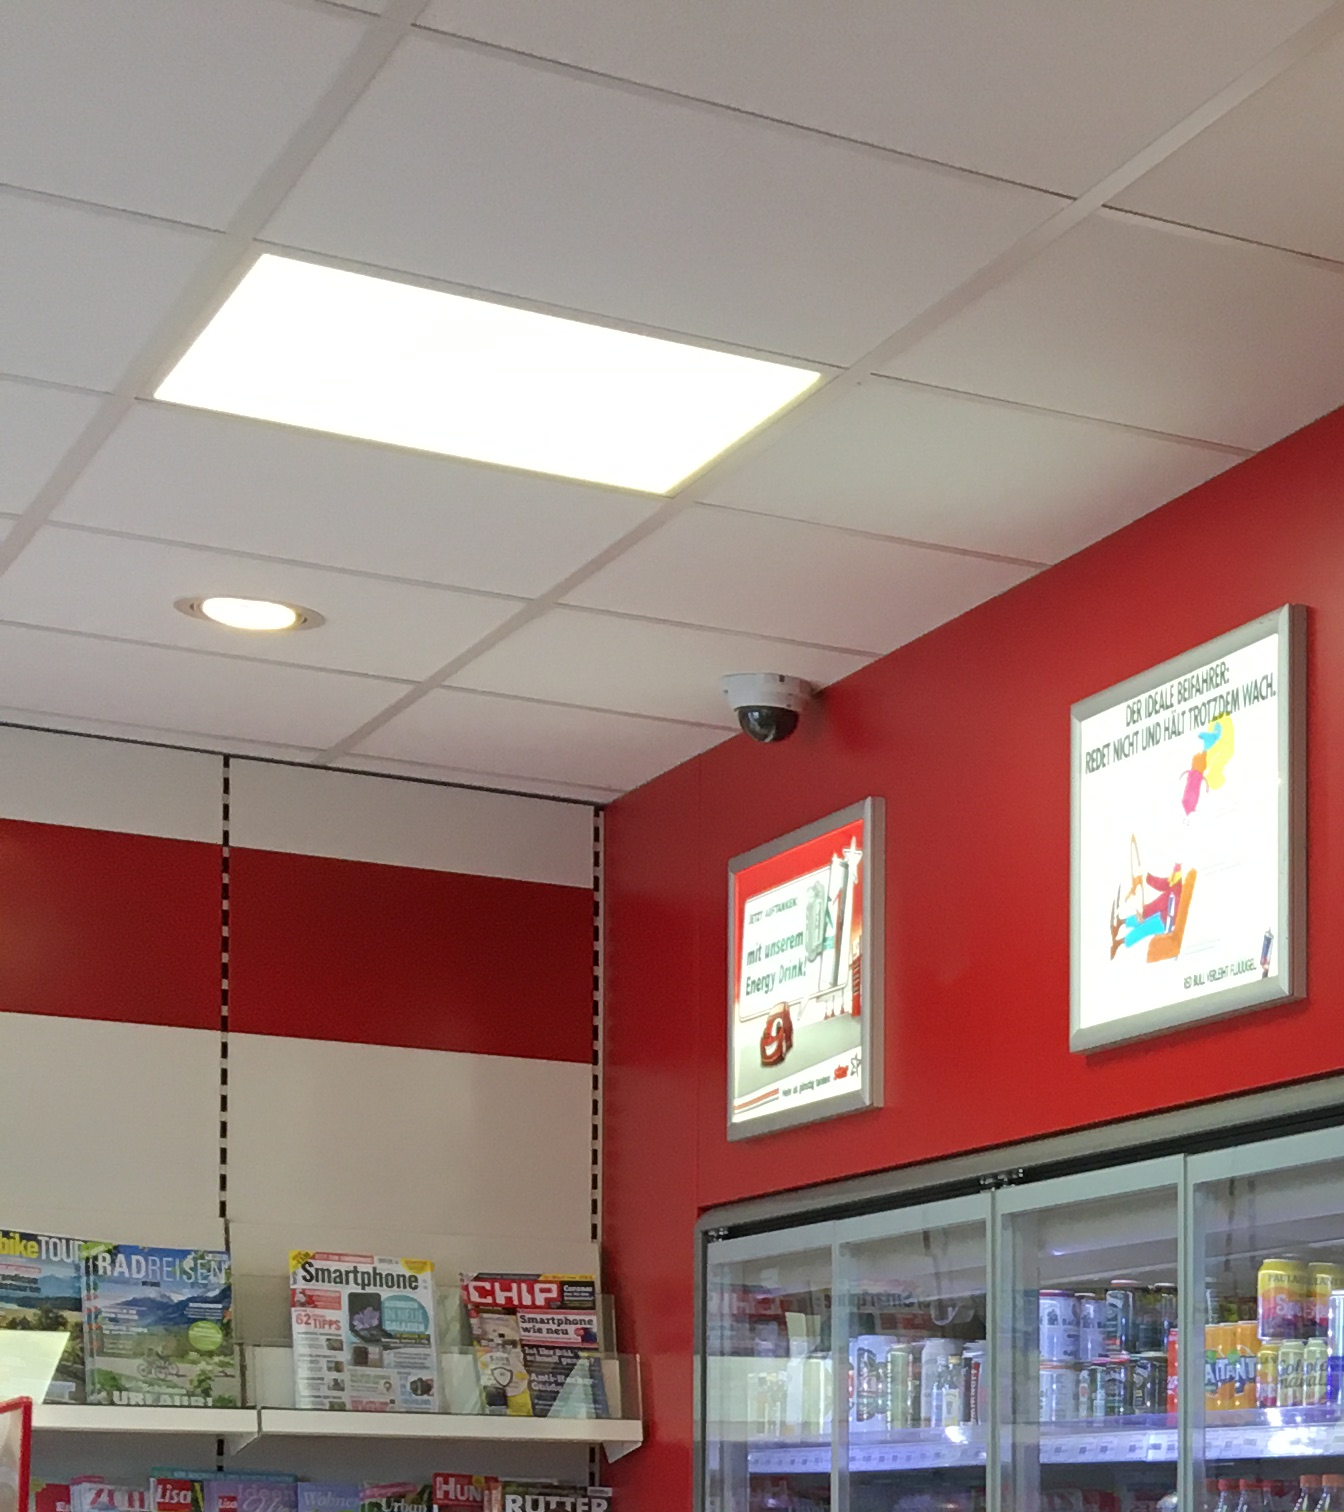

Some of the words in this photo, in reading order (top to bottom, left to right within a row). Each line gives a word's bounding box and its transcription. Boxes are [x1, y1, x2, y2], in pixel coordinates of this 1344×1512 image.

[1126, 704, 1142, 727] DER
[1144, 685, 1174, 719] IDEALE
[1177, 662, 1229, 704] BEIFAHRER:
[1085, 743, 1111, 774] REDET
[1113, 731, 1139, 762] NICHT
[1142, 722, 1161, 751] UND
[1164, 709, 1186, 741] HÄLT
[1189, 687, 1240, 730] TROTZDEM
[1242, 673, 1276, 708] WACH.
[747, 942, 762, 966] mit
[765, 931, 803, 959] unserem
[746, 972, 776, 996] Energy
[779, 956, 807, 984] Drink!
[301, 1261, 419, 1290] Smartphone
[469, 1281, 558, 1306] CHIP
[519, 1315, 594, 1327] Smartphone
[522, 1326, 543, 1335] wie
[545, 1327, 569, 1335] neu
[157, 1484, 192, 1505] Lisa
